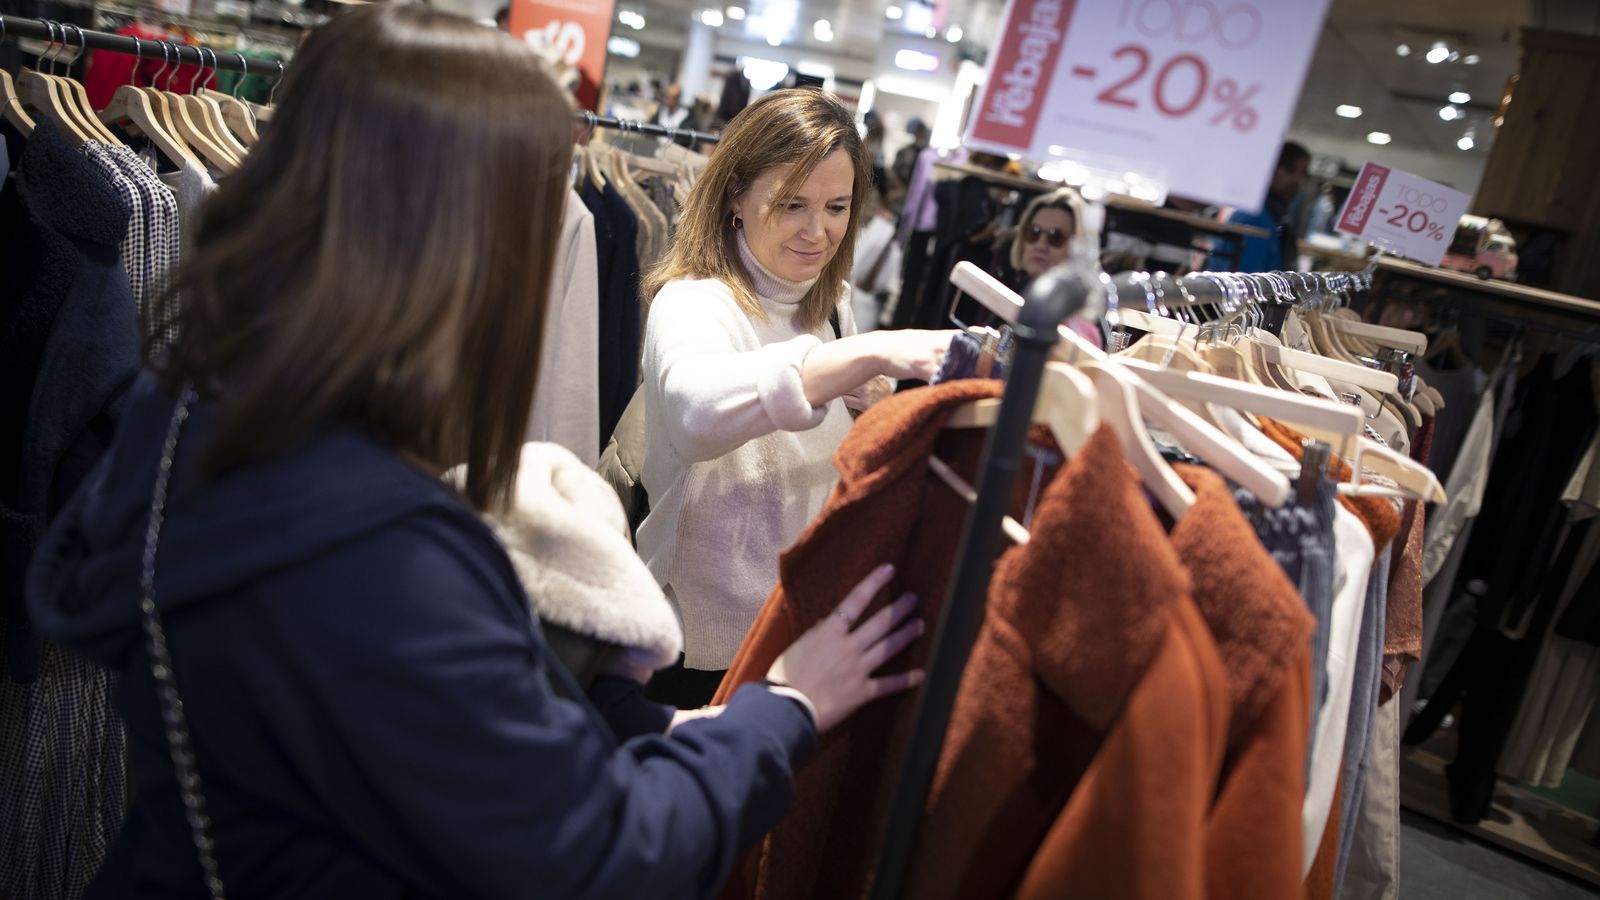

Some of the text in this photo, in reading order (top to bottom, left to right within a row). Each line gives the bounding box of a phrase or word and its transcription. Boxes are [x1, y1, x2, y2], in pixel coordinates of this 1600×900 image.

[1001, 0, 1061, 127] rebaja
[1071, 42, 1261, 133] -20%
[1379, 204, 1445, 241] -20%
[1398, 185, 1448, 214] TODO
